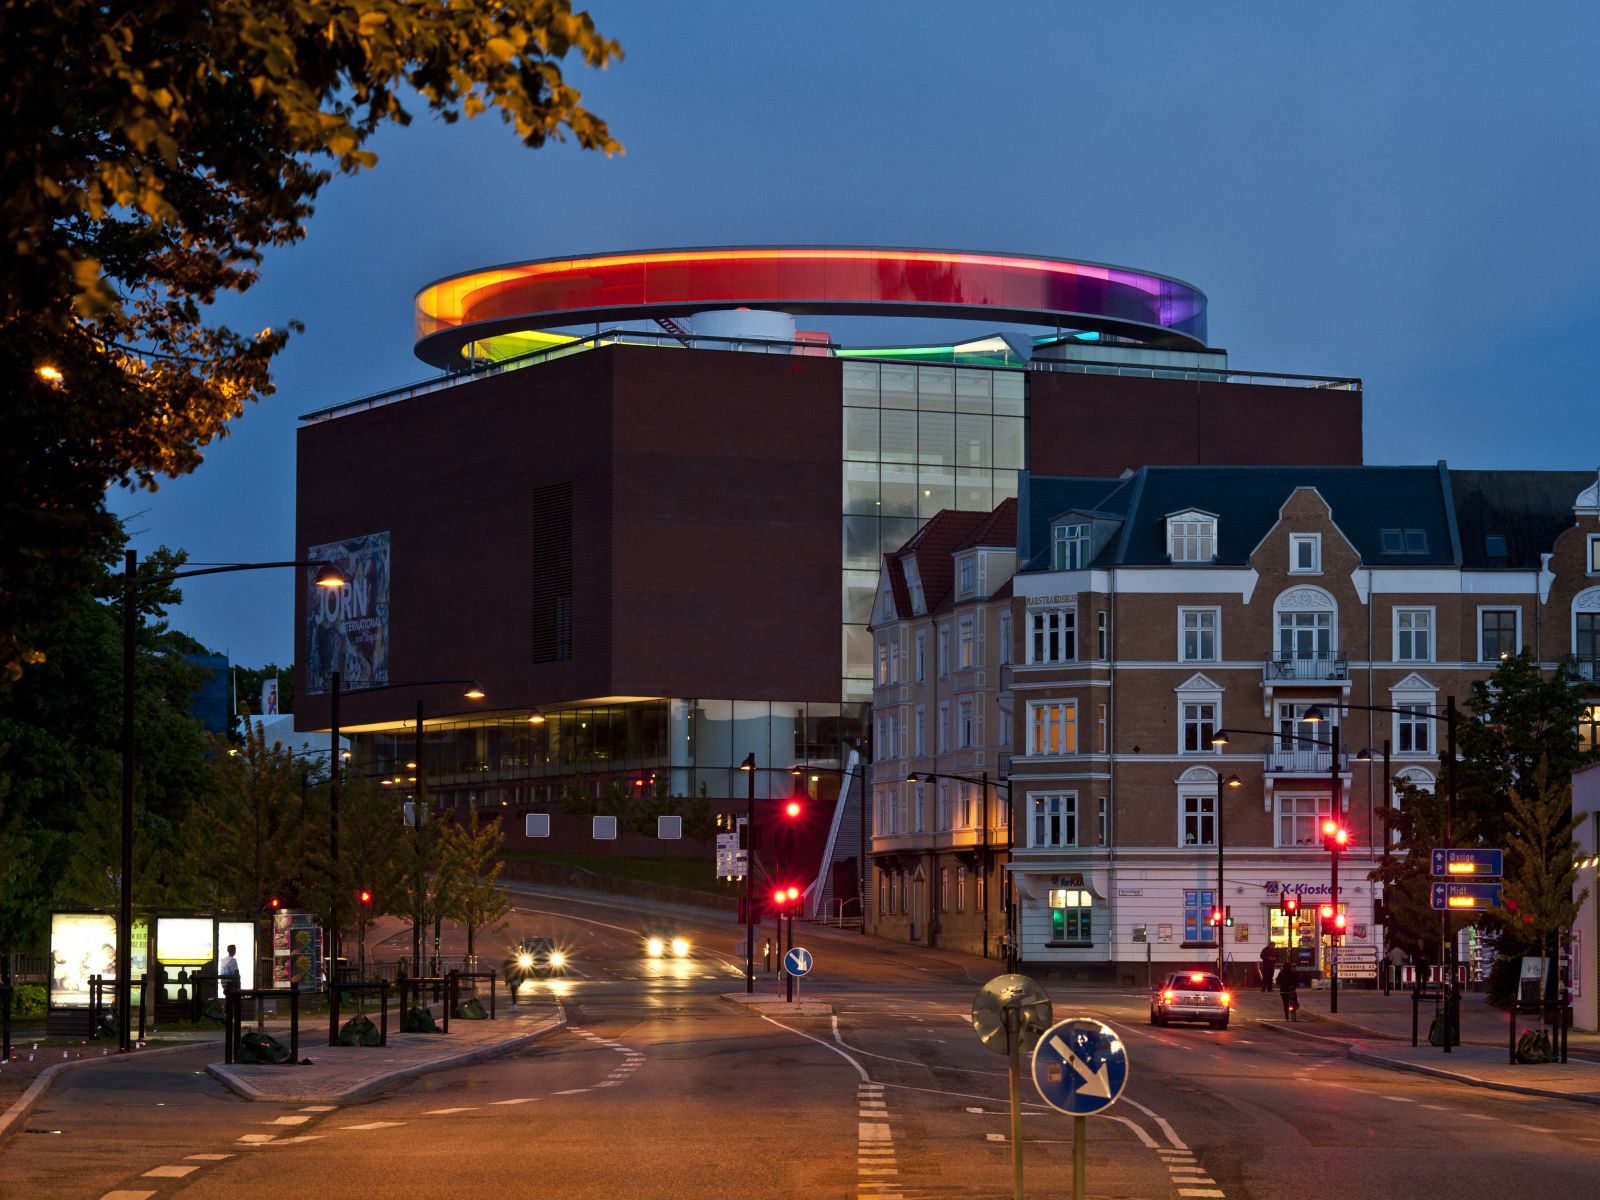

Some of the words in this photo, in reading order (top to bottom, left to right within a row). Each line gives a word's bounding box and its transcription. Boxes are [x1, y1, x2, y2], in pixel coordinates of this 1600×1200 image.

[315, 578, 367, 624] JORN
[1450, 852, 1474, 863] Øvrige
[1449, 863, 1474, 872] Lukket
[1450, 886, 1467, 895] Midt
[1436, 898, 1443, 906] P
[1449, 897, 1474, 906] Lukket
